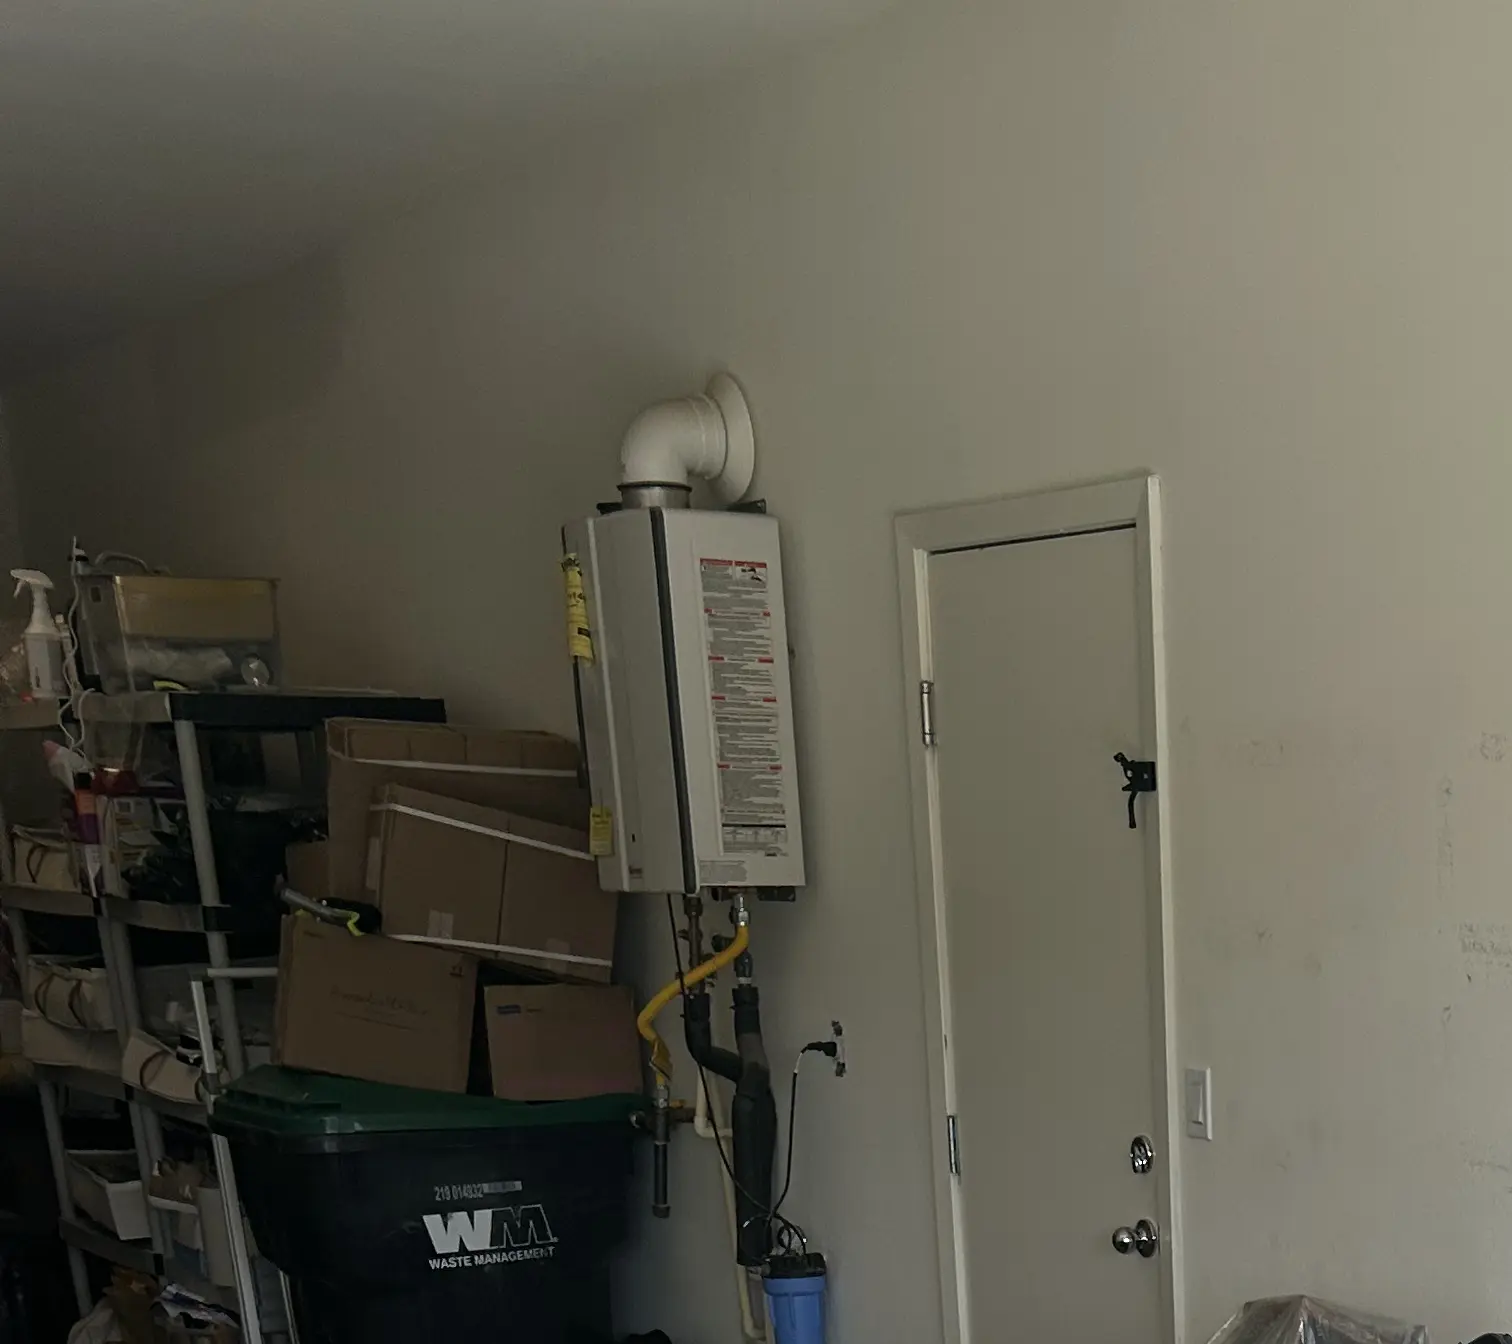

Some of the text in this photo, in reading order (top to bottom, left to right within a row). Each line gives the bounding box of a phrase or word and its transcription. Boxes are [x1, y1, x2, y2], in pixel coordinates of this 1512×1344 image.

[422, 1203, 554, 1255] WM
[428, 1246, 555, 1270] WASTE MANAGEMENT
